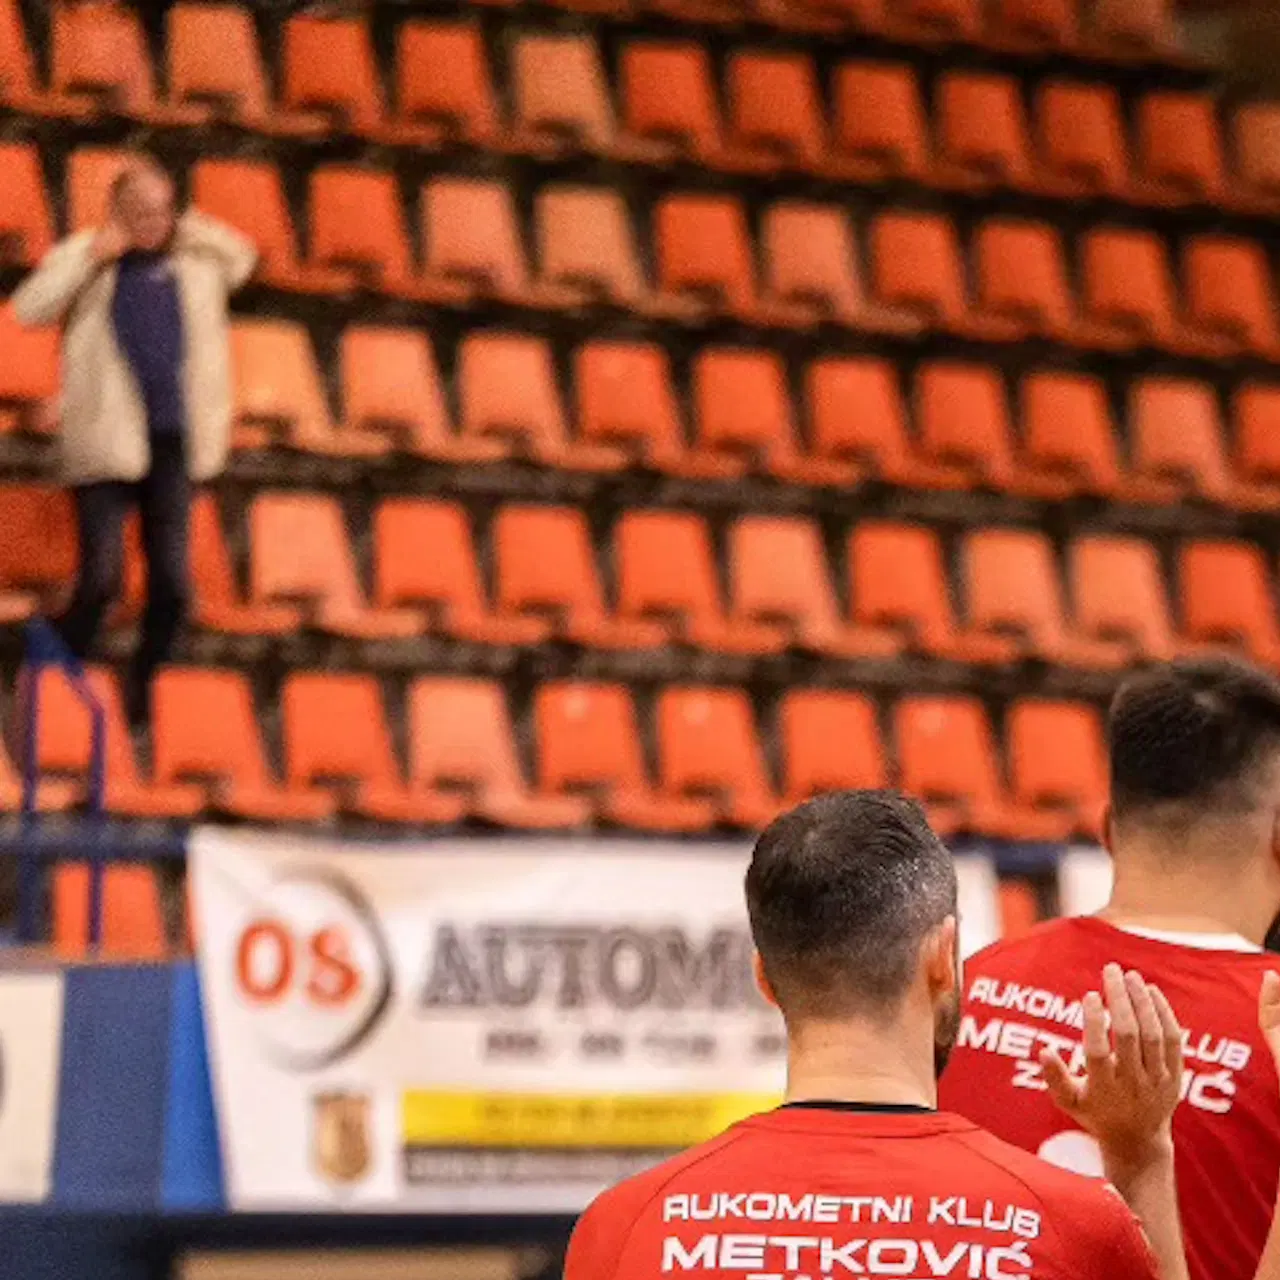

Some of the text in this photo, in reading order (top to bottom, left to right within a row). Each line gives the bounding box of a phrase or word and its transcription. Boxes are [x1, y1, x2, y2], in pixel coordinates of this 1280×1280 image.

[236, 919, 362, 1006] OS
[420, 923, 757, 1014] AUTOM
[968, 976, 1253, 1072] RUKOM LUB
[662, 1192, 1042, 1240] RUKOMETNI KLUB
